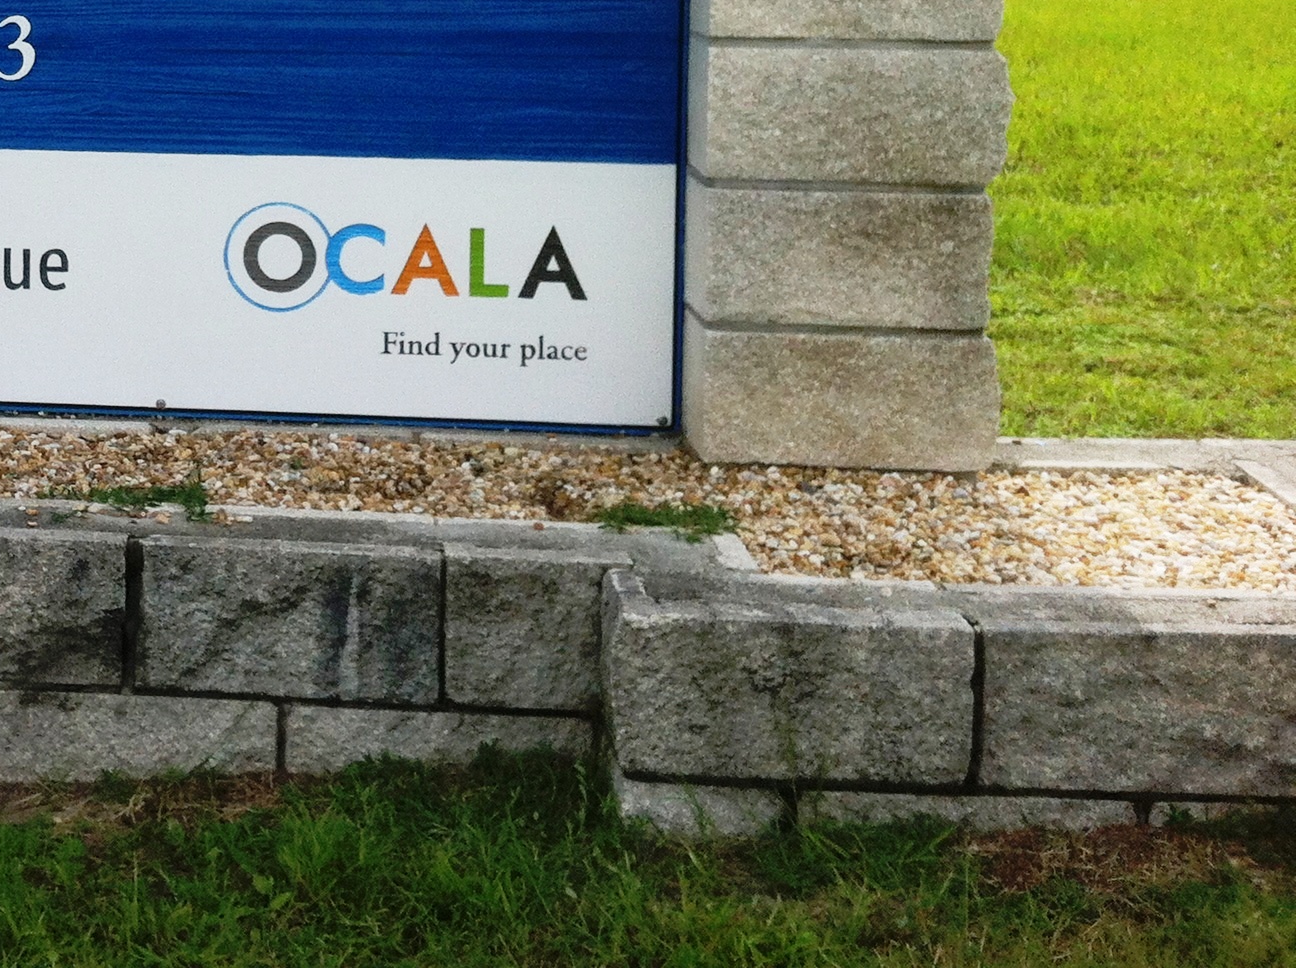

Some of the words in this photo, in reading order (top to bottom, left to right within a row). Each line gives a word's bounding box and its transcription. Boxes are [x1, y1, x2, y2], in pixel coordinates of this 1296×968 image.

[242, 221, 588, 301] OCALA
[381, 330, 442, 356] Find
[449, 341, 511, 365] your
[519, 334, 588, 367] place
